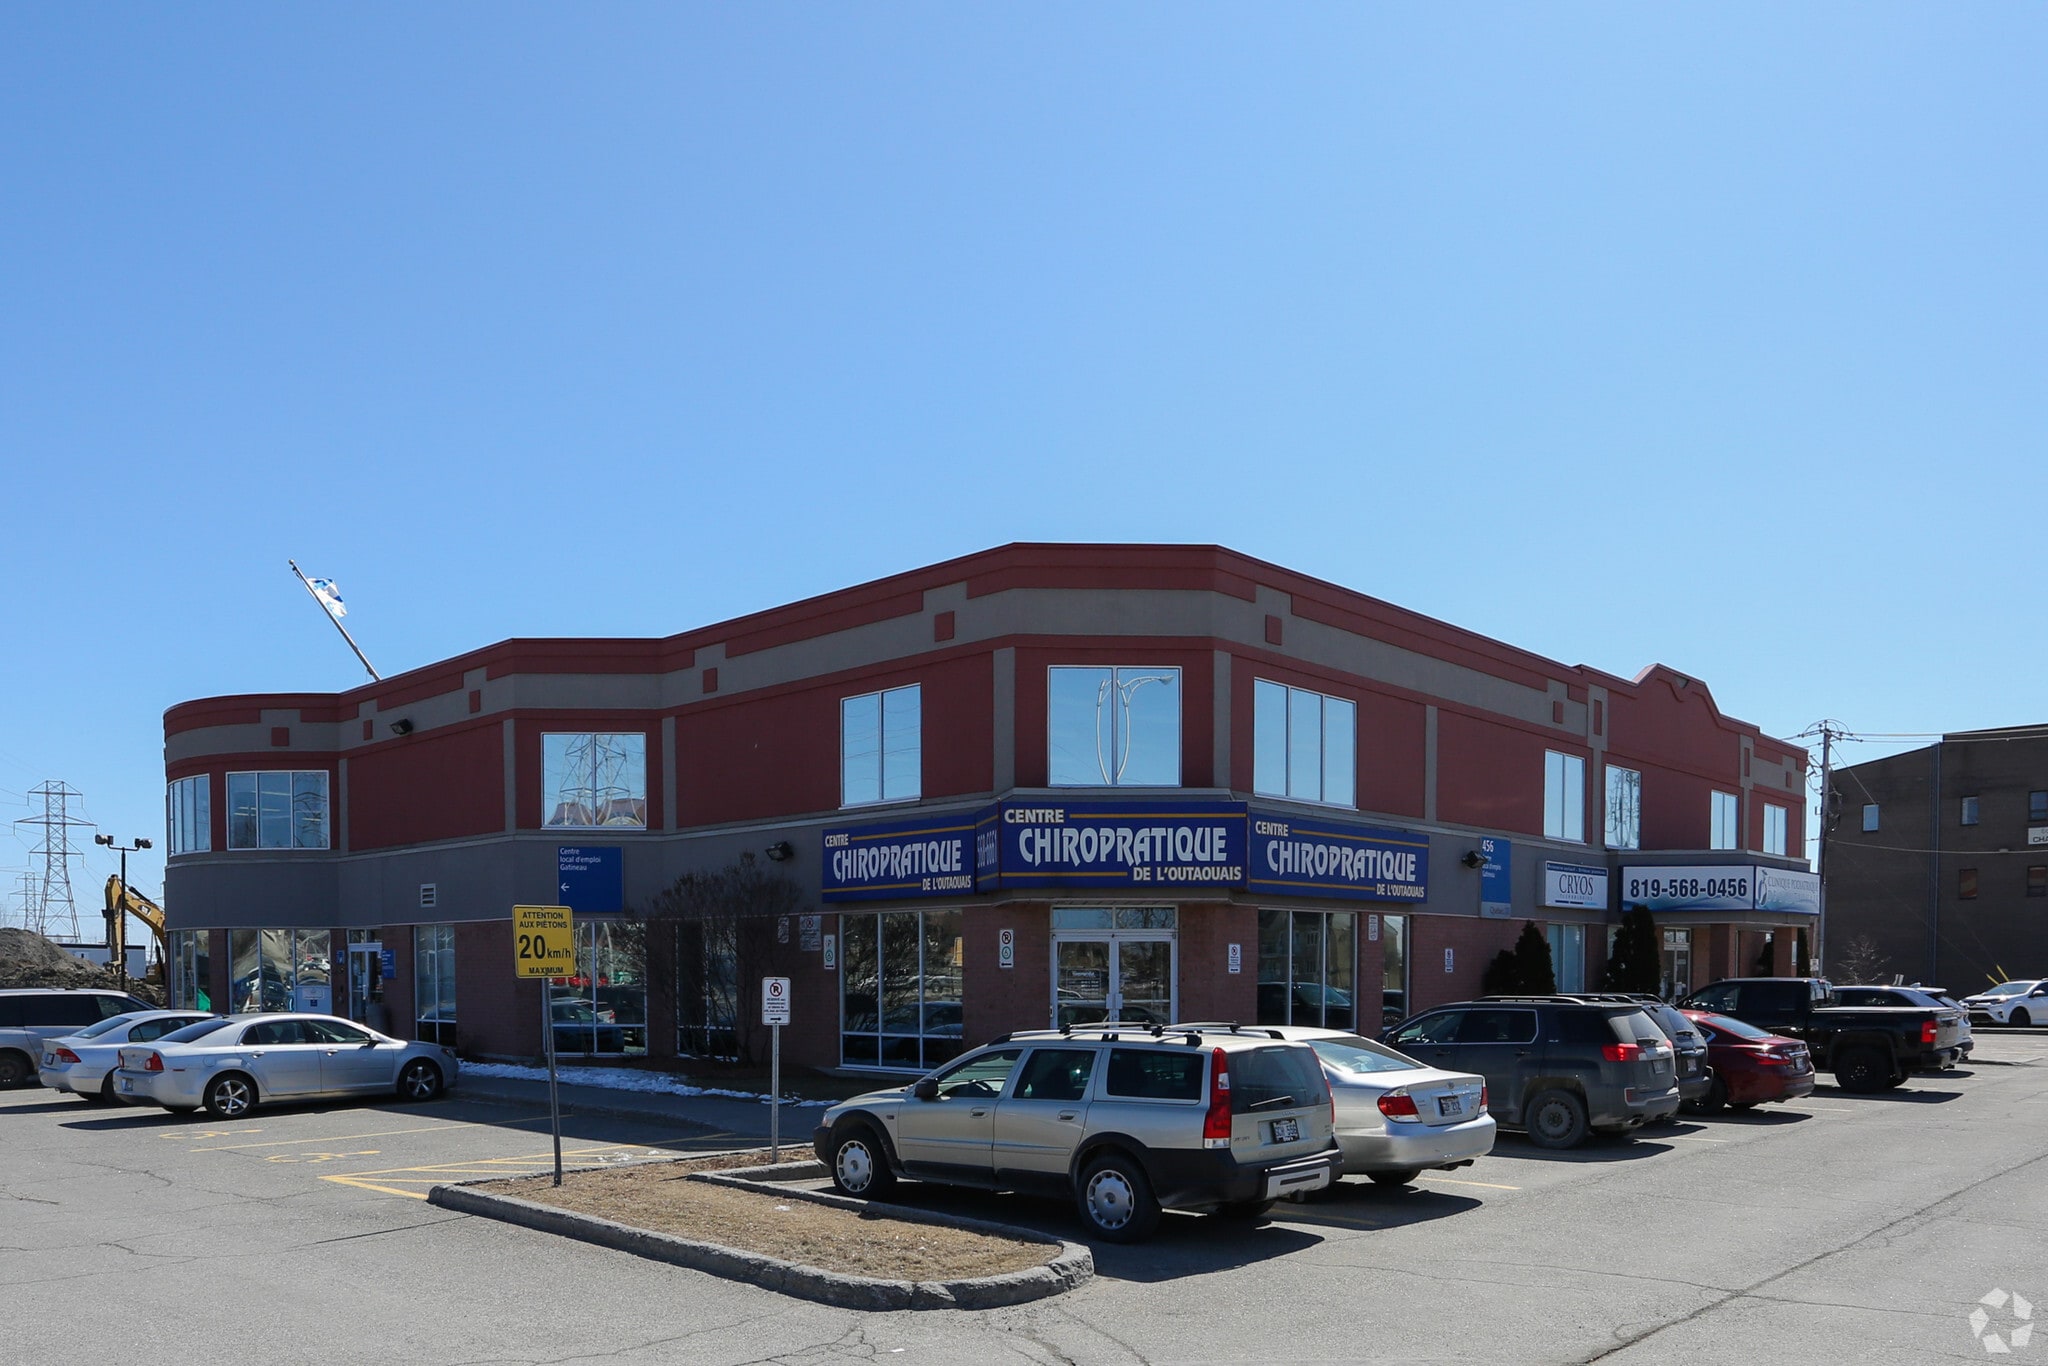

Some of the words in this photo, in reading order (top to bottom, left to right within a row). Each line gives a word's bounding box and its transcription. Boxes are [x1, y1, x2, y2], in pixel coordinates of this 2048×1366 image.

[1004, 809, 1065, 823] CENTRE
[1255, 821, 1289, 837] CENTRE
[824, 833, 849, 848] CENTRE
[1019, 826, 1227, 867] CHIROPRATIQUE
[1482, 839, 1494, 852] 456
[560, 847, 580, 855] Centre
[560, 863, 588, 871] Gatineau
[575, 856, 602, 864] d'emploi
[832, 839, 962, 883] CHIROPRATIQUE
[1266, 840, 1417, 882] CHIROPRATIQUE
[1133, 866, 1151, 881] DE
[1157, 866, 1242, 881] L'OUTAOUAIS
[922, 878, 931, 891] DE
[932, 875, 972, 890] L'OUTAOUAIS
[1376, 883, 1386, 896] DE
[1387, 884, 1425, 898] L'OUTAOUAIS
[1558, 873, 1594, 896] CRYOS
[1630, 878, 1748, 898] 819-568-0456
[522, 911, 564, 919] ATTENTION
[518, 934, 546, 960] 20
[547, 947, 571, 959] km/h
[528, 966, 564, 974] MAXIMUM
